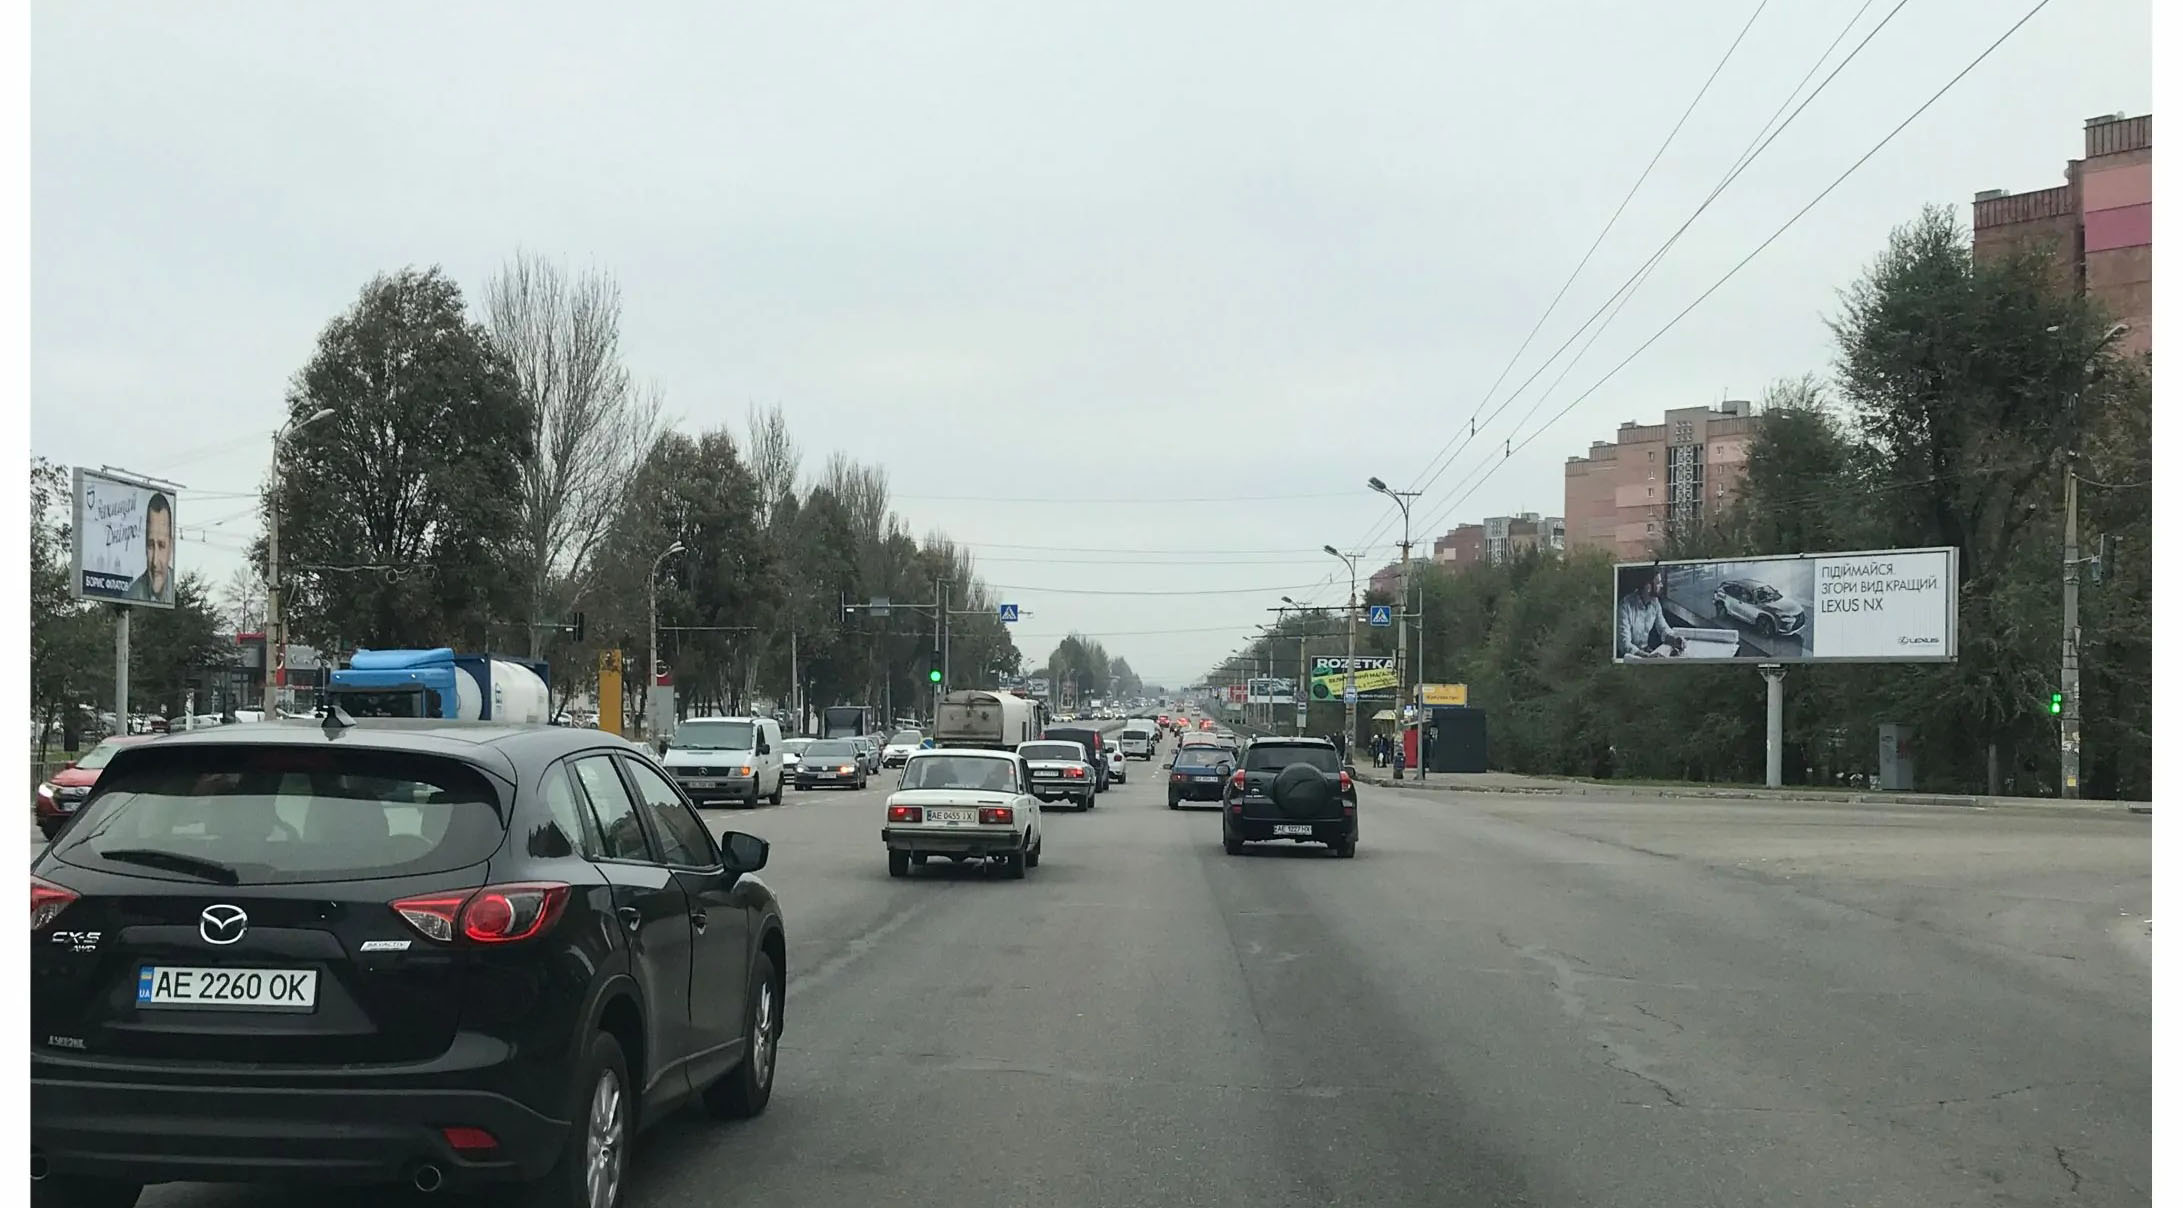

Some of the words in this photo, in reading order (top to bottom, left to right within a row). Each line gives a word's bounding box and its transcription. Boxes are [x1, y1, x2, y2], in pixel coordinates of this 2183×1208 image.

[1821, 582, 1857, 594] ЗГОРИ
[1861, 580, 1884, 594] ВИД
[1821, 598, 1859, 613] LEXUS
[1864, 598, 1883, 611] NX
[1317, 658, 1394, 669] ROZETKA
[52, 931, 102, 944] CX-5
[155, 971, 193, 998] AE
[199, 972, 262, 1000] 2260
[269, 974, 308, 1001] OK
[139, 990, 150, 998] UA
